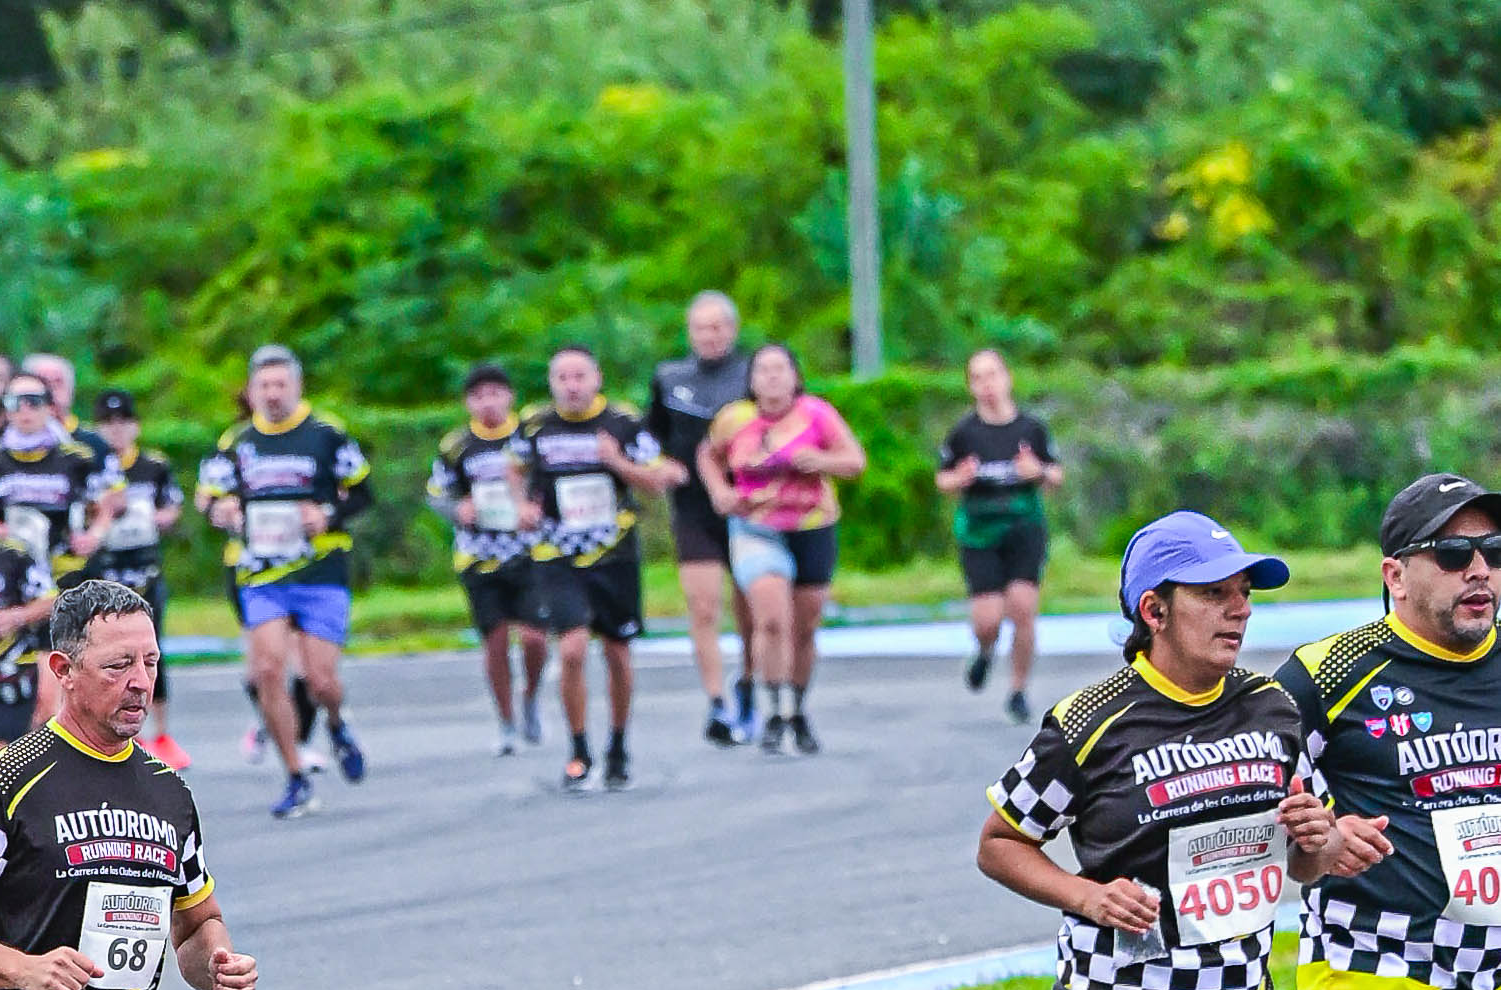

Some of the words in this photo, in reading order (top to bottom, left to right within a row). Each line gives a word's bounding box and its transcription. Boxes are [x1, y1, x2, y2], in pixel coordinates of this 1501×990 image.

[1131, 731, 1291, 785] AUTÓDROMO
[1164, 768, 1235, 800] RUNNING
[1237, 763, 1276, 784] RACE
[1430, 766, 1496, 794] RUNNING
[55, 801, 178, 851] AUTÓDROMO
[1152, 805, 1190, 821] Carrera
[1191, 801, 1204, 812] de
[80, 842, 132, 861] RUNNING
[134, 845, 168, 866] RACE
[1188, 826, 1275, 856] AUTÓDROMO
[55, 869, 67, 879] La
[68, 867, 99, 877] Carrera
[142, 868, 155, 879] del
[1179, 864, 1282, 921] 4050
[108, 938, 148, 972] 68
